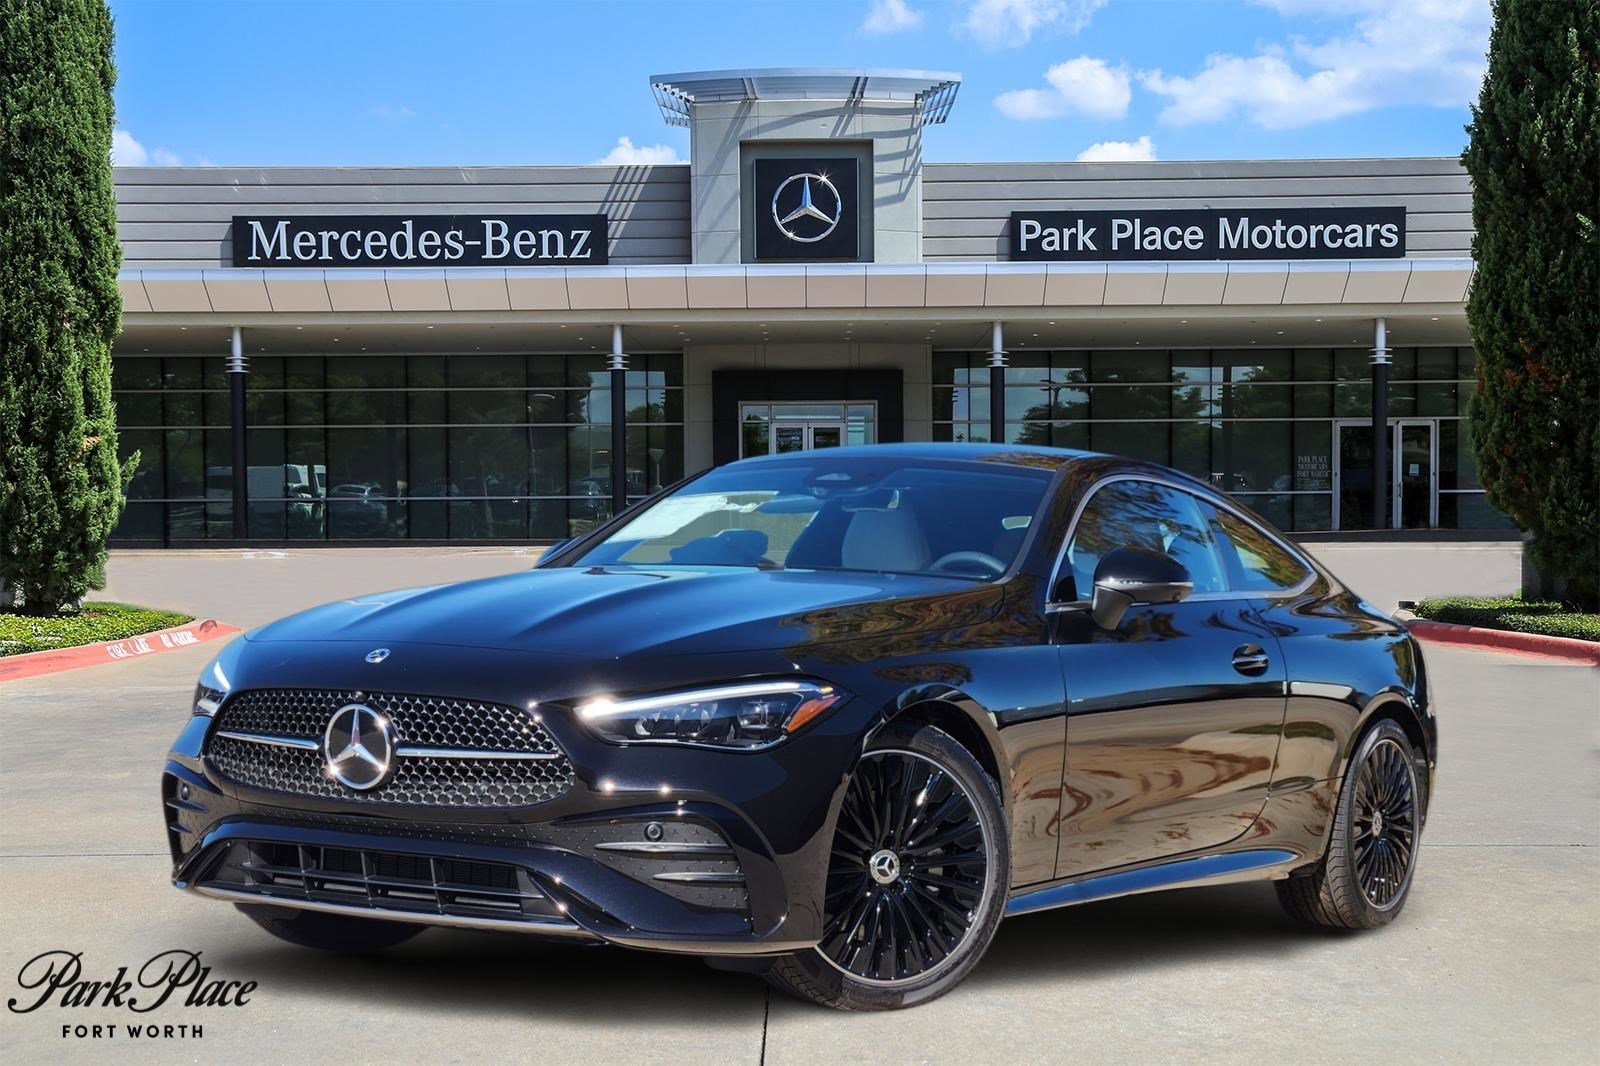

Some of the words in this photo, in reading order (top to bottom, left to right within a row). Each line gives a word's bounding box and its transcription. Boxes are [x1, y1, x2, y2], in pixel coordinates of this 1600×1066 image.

[247, 219, 592, 261] Mercedes-Benz
[1019, 219, 1098, 252] Park
[1112, 218, 1205, 251] Place
[1219, 216, 1399, 250] Motorcars
